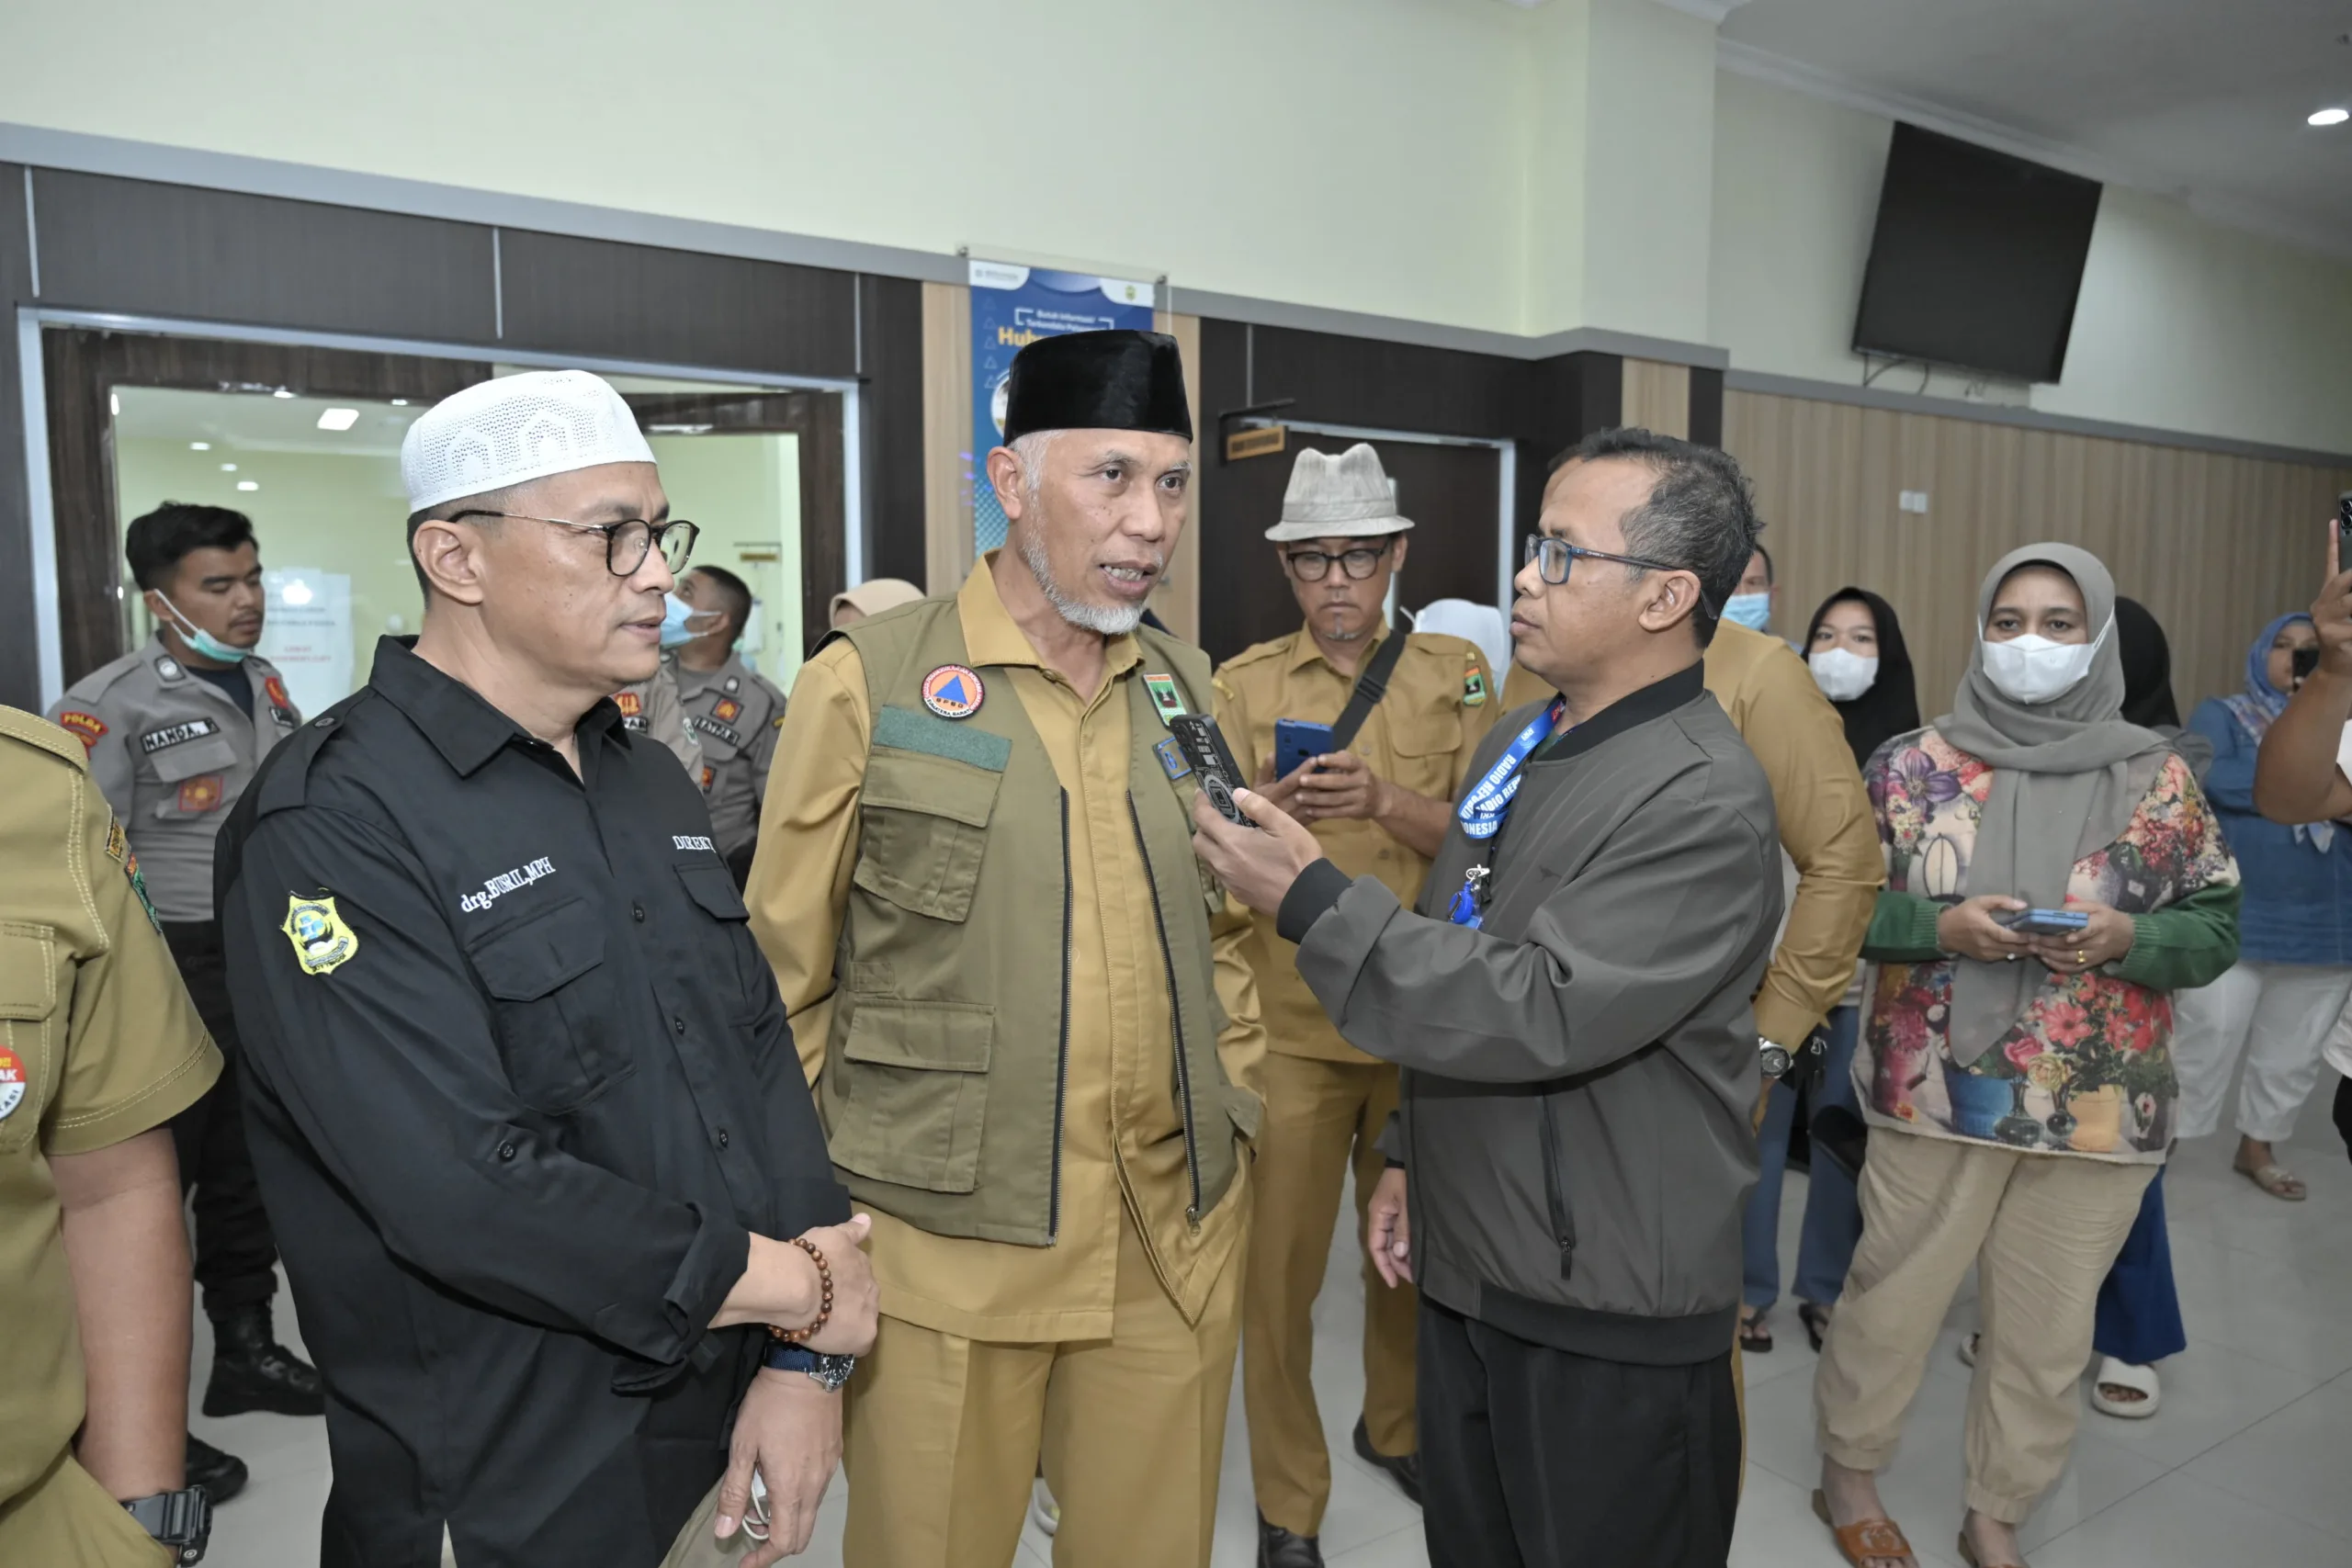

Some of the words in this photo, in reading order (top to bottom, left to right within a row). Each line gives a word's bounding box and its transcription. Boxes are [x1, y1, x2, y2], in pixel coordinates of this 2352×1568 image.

[63, 714, 102, 733] POLDA
[1521, 727, 1534, 741] RRI
[1489, 753, 1517, 785] RADIO
